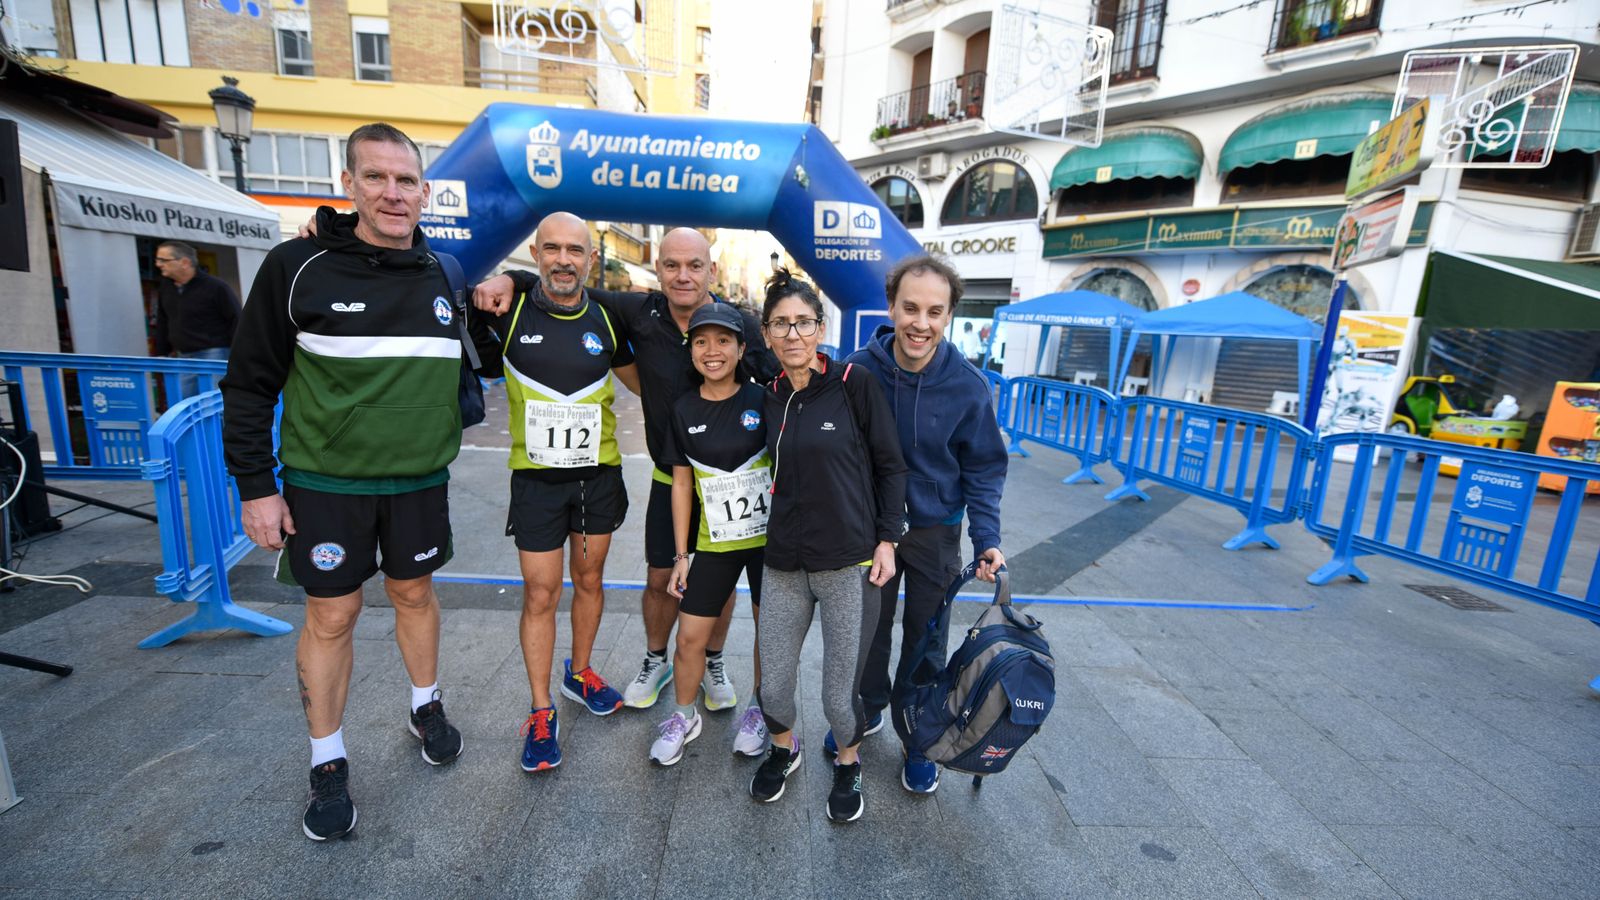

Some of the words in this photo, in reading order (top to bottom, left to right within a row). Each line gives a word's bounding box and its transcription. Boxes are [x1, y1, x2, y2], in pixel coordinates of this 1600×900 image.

[569, 129, 761, 161] Ayuntamiento
[956, 146, 1029, 175] ABOGADOS
[591, 161, 624, 187] de
[630, 163, 661, 189] La
[667, 165, 739, 193] Línea
[78, 194, 157, 224] Kiosko
[164, 207, 214, 233] Plaza
[219, 217, 271, 240] Iglesia
[445, 216, 456, 225] DE
[823, 210, 840, 229] D
[814, 238, 859, 246] DELEGACIÓN
[1158, 223, 1223, 243] Maximino
[815, 248, 882, 261] DEPORTES
[951, 236, 1017, 255] CROOKE
[1035, 315, 1072, 324] ATLETISMO
[1074, 316, 1105, 325] LINENSE
[90, 380, 136, 389] DEPORTES
[546, 427, 590, 449] 112
[1471, 473, 1523, 489] DEPORTES
[722, 492, 768, 522] 124
